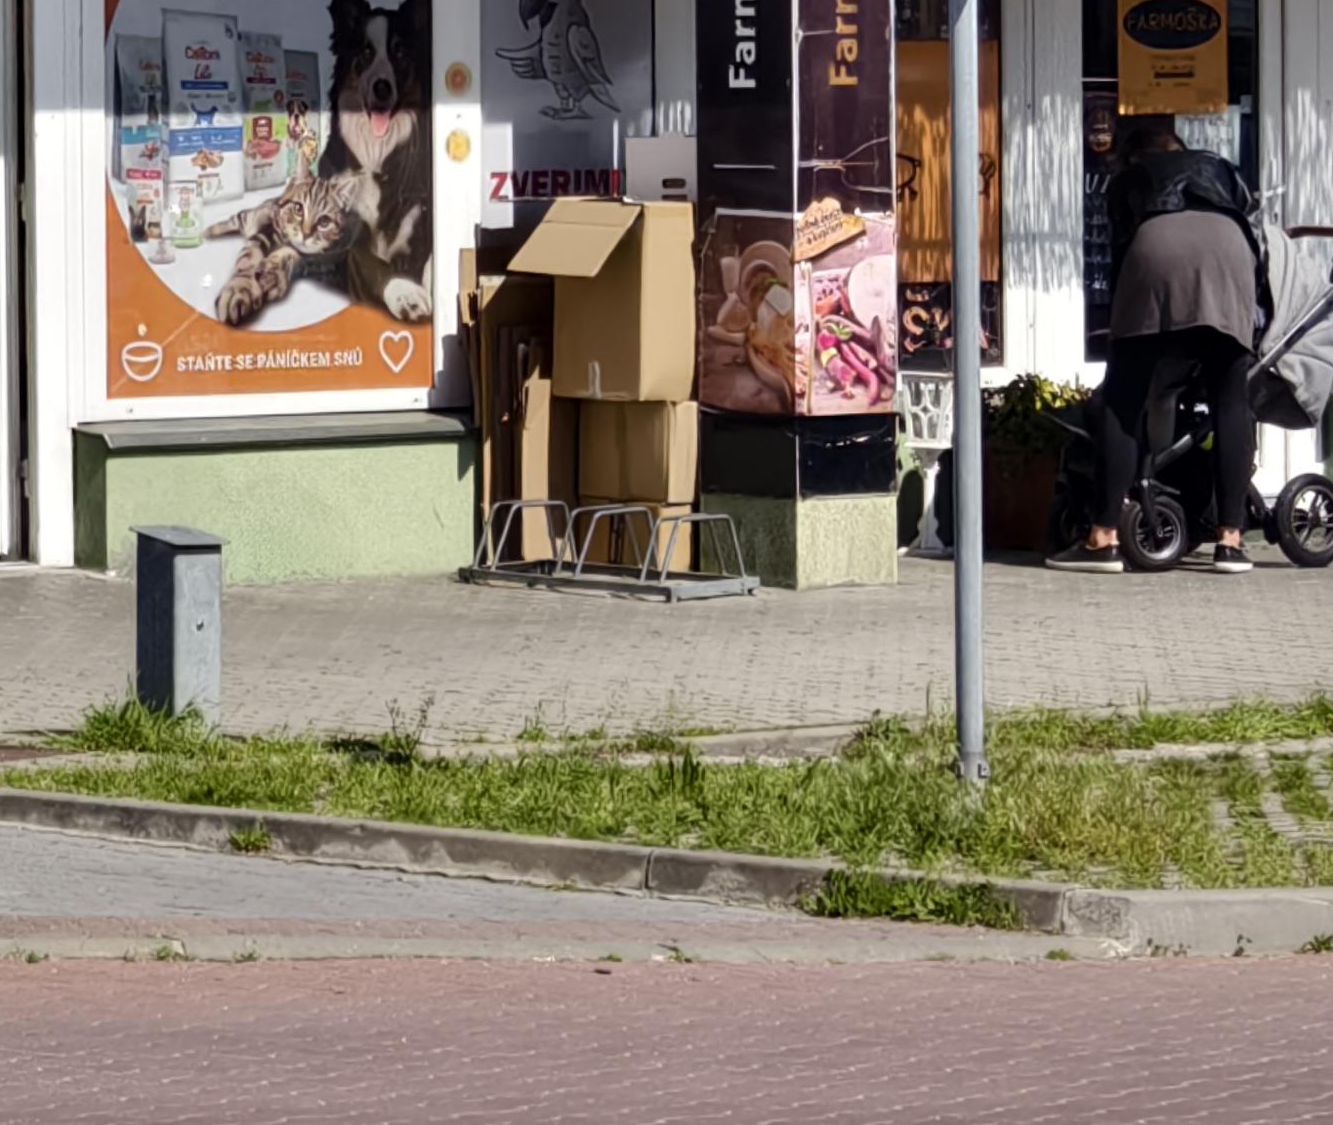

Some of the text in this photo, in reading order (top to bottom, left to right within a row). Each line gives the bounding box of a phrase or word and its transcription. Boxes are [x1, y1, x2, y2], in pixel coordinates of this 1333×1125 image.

[177, 352, 232, 372] STAŇTE
[236, 354, 254, 369] SE
[257, 349, 330, 369] PÁNÍČKEM
